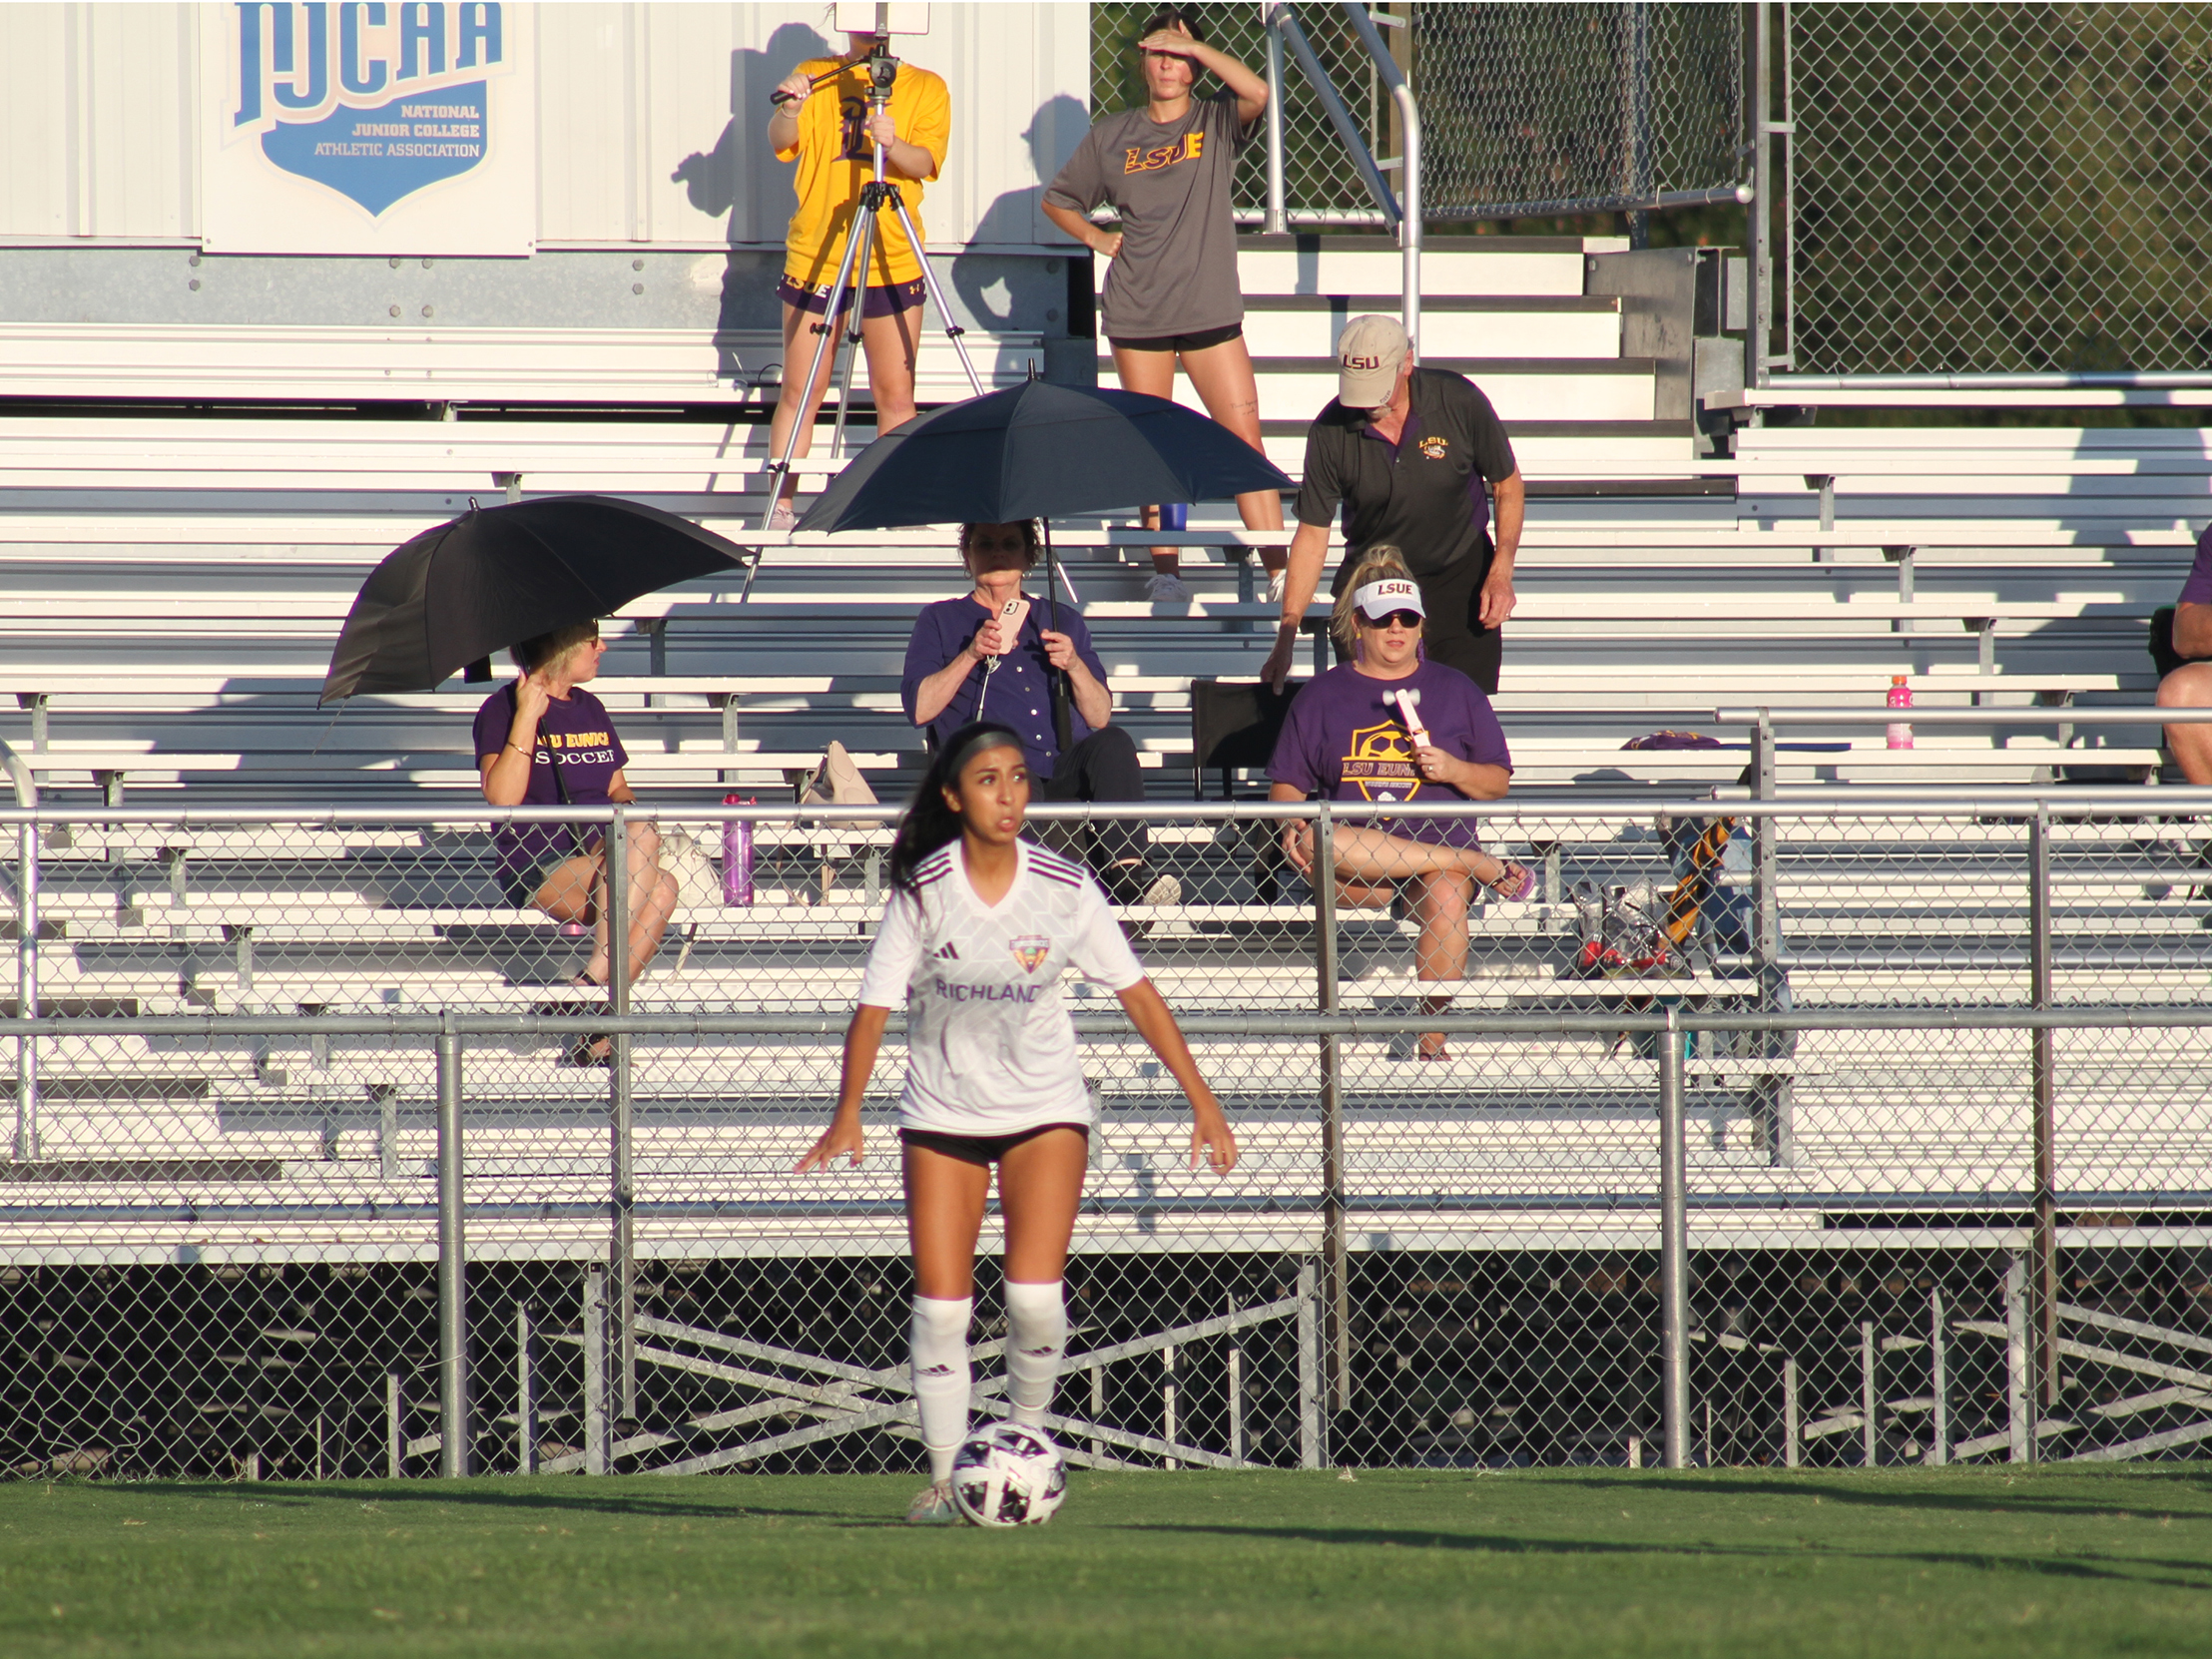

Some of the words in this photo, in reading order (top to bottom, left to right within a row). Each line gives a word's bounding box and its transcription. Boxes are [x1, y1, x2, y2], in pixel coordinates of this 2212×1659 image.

[234, 2, 503, 128] NJCAA
[401, 105, 480, 119] NATIONAL
[351, 123, 410, 137] JUNIOR
[413, 124, 480, 138] COLLEGE
[313, 143, 383, 156] ATHLETIC
[386, 144, 480, 157] ASSOCIATION
[1124, 132, 1205, 175] LSUE
[1343, 353, 1381, 370] LSU
[1378, 583, 1413, 596] LSUE
[1342, 762, 1375, 776] LSU
